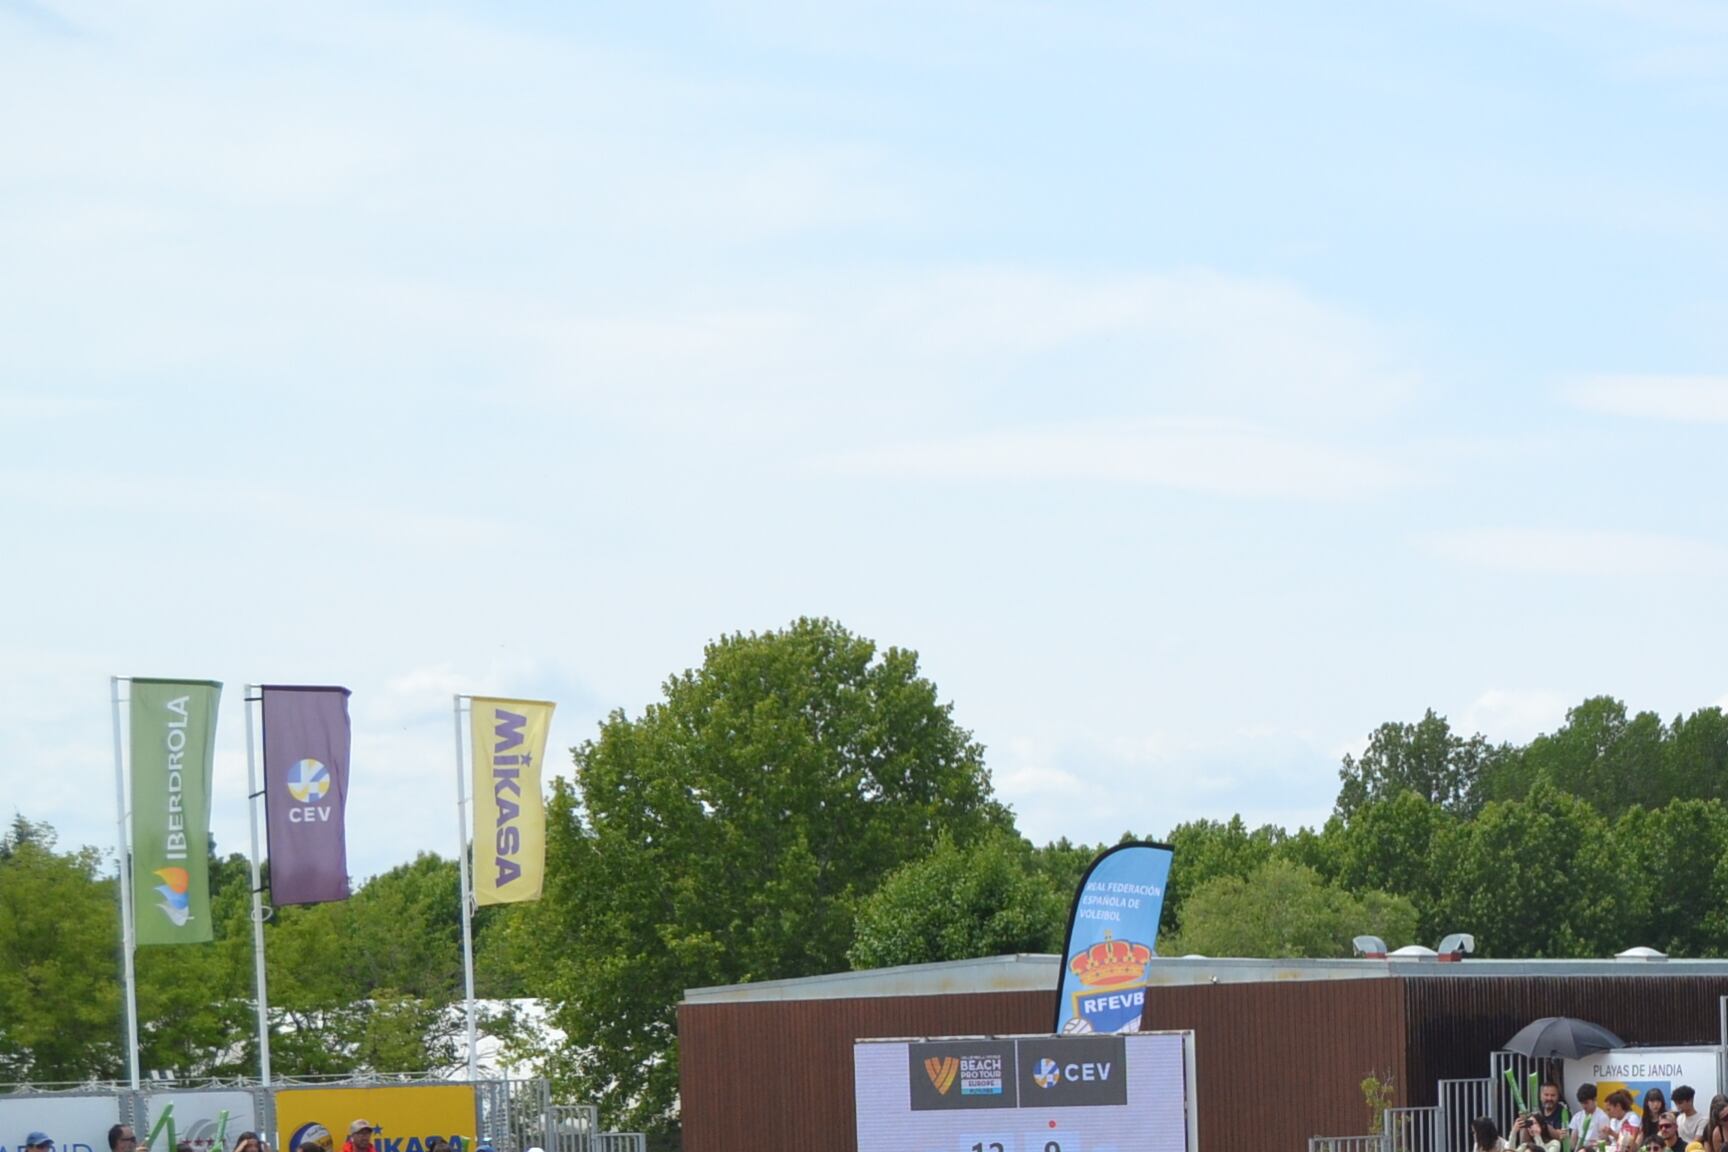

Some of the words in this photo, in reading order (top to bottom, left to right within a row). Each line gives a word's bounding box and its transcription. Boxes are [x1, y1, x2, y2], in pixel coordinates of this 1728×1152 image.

[165, 694, 190, 860] IBERDROLA
[288, 807, 331, 824] CEV
[1086, 882, 1106, 892] REAL
[1108, 882, 1161, 897] FEDERACIÓN
[1083, 895, 1127, 908] ESPAÑOLA
[1128, 899, 1140, 909] DE
[1079, 909, 1121, 922] VOLEIBOL
[1084, 991, 1145, 1014] RFEVB
[960, 1059, 1001, 1070] BEACH
[1064, 1062, 1111, 1081] CEV
[1593, 1064, 1630, 1077] PLAYAS
[1632, 1064, 1645, 1077] DE
[1648, 1064, 1683, 1077] JANDIA
[961, 1070, 979, 1079] PRO
[980, 1070, 1001, 1078] TOUR
